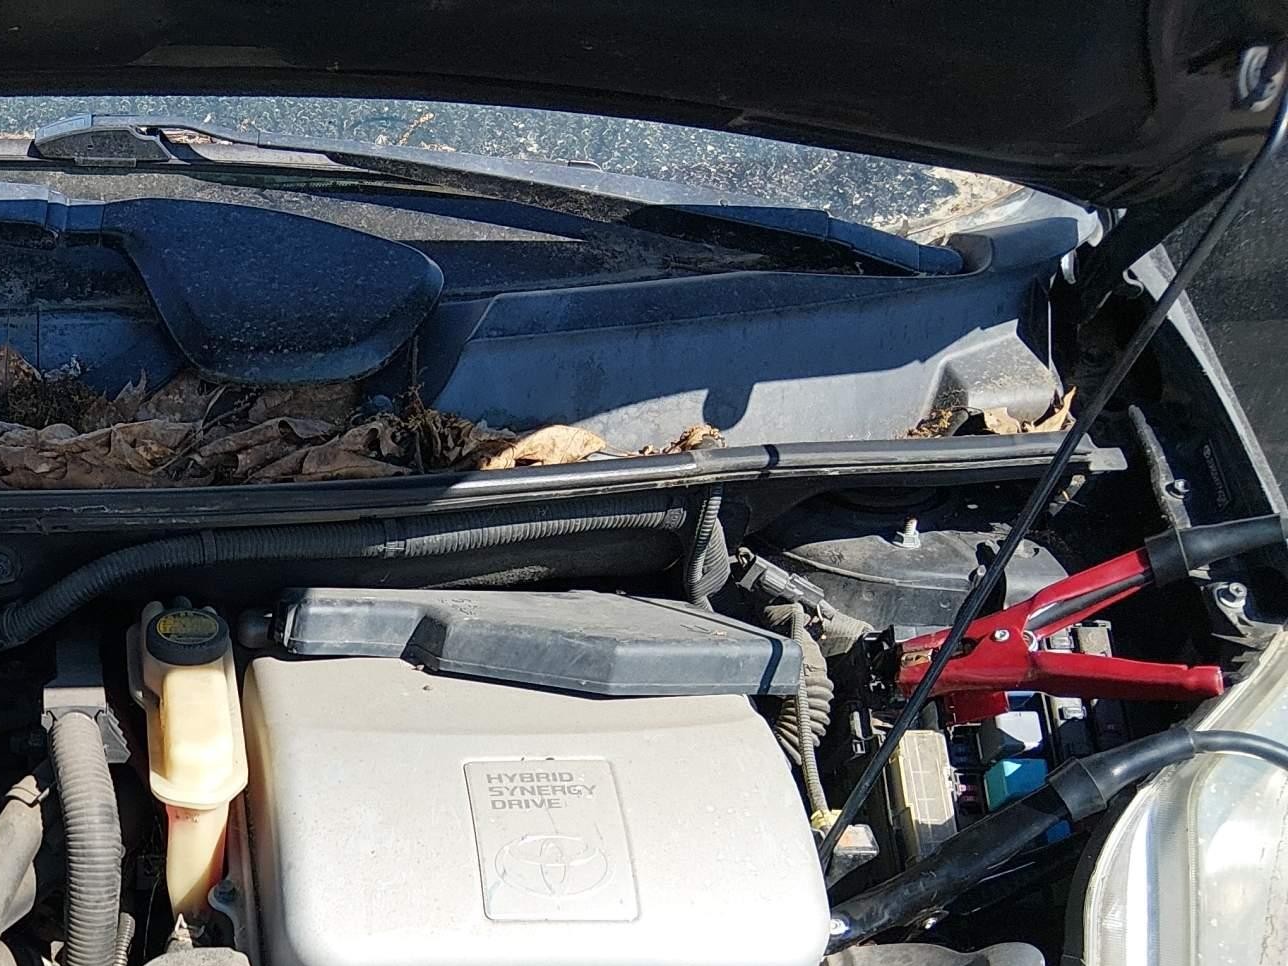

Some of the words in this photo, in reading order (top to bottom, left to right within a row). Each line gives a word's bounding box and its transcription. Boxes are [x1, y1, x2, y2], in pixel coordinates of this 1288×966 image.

[486, 771, 575, 784] HYBRID
[488, 784, 597, 797] SYNERGY
[490, 797, 563, 810] DRIVE
